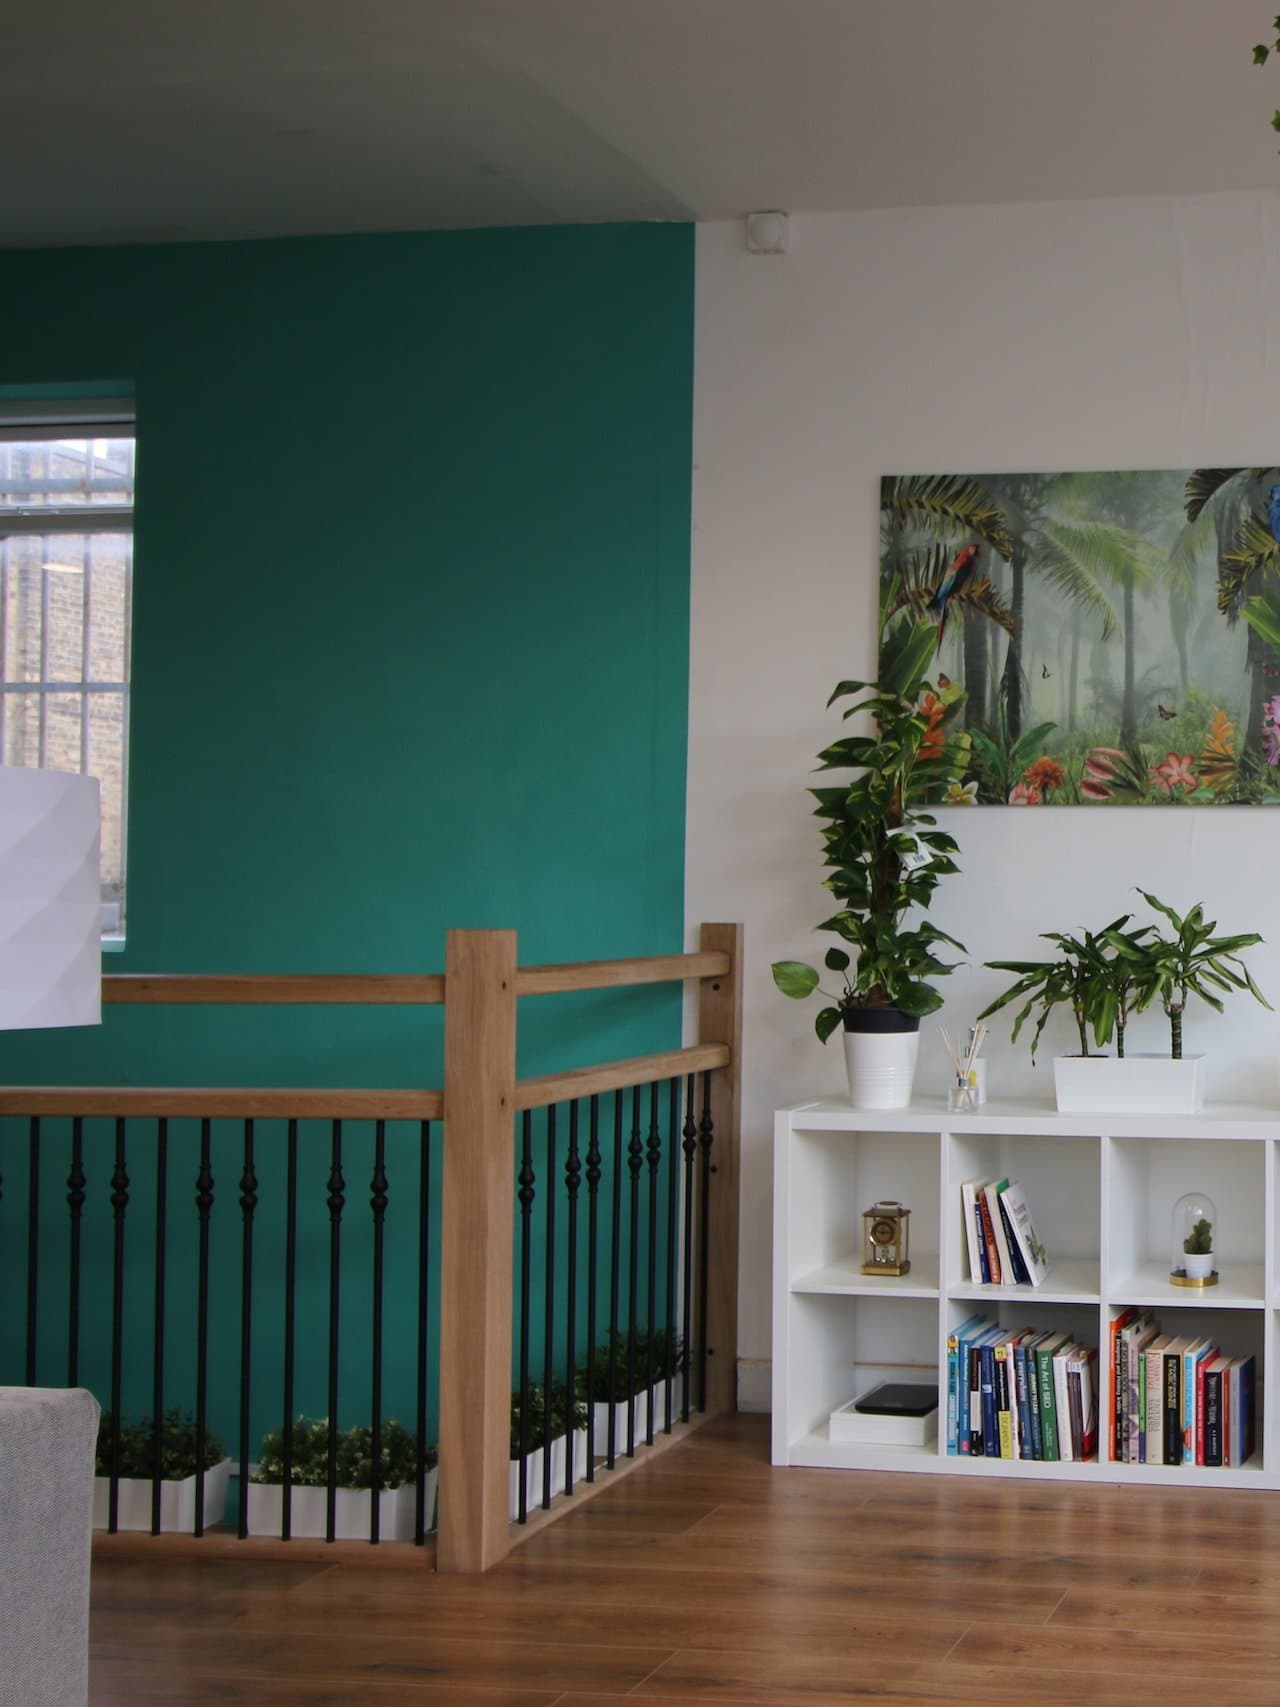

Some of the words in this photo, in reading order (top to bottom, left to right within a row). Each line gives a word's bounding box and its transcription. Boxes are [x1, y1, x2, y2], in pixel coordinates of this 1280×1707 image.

[1040, 1356, 1049, 1370] The
[1041, 1370, 1050, 1382] Art
[1042, 1383, 1050, 1391] of
[1042, 1391, 1052, 1409] SEO
